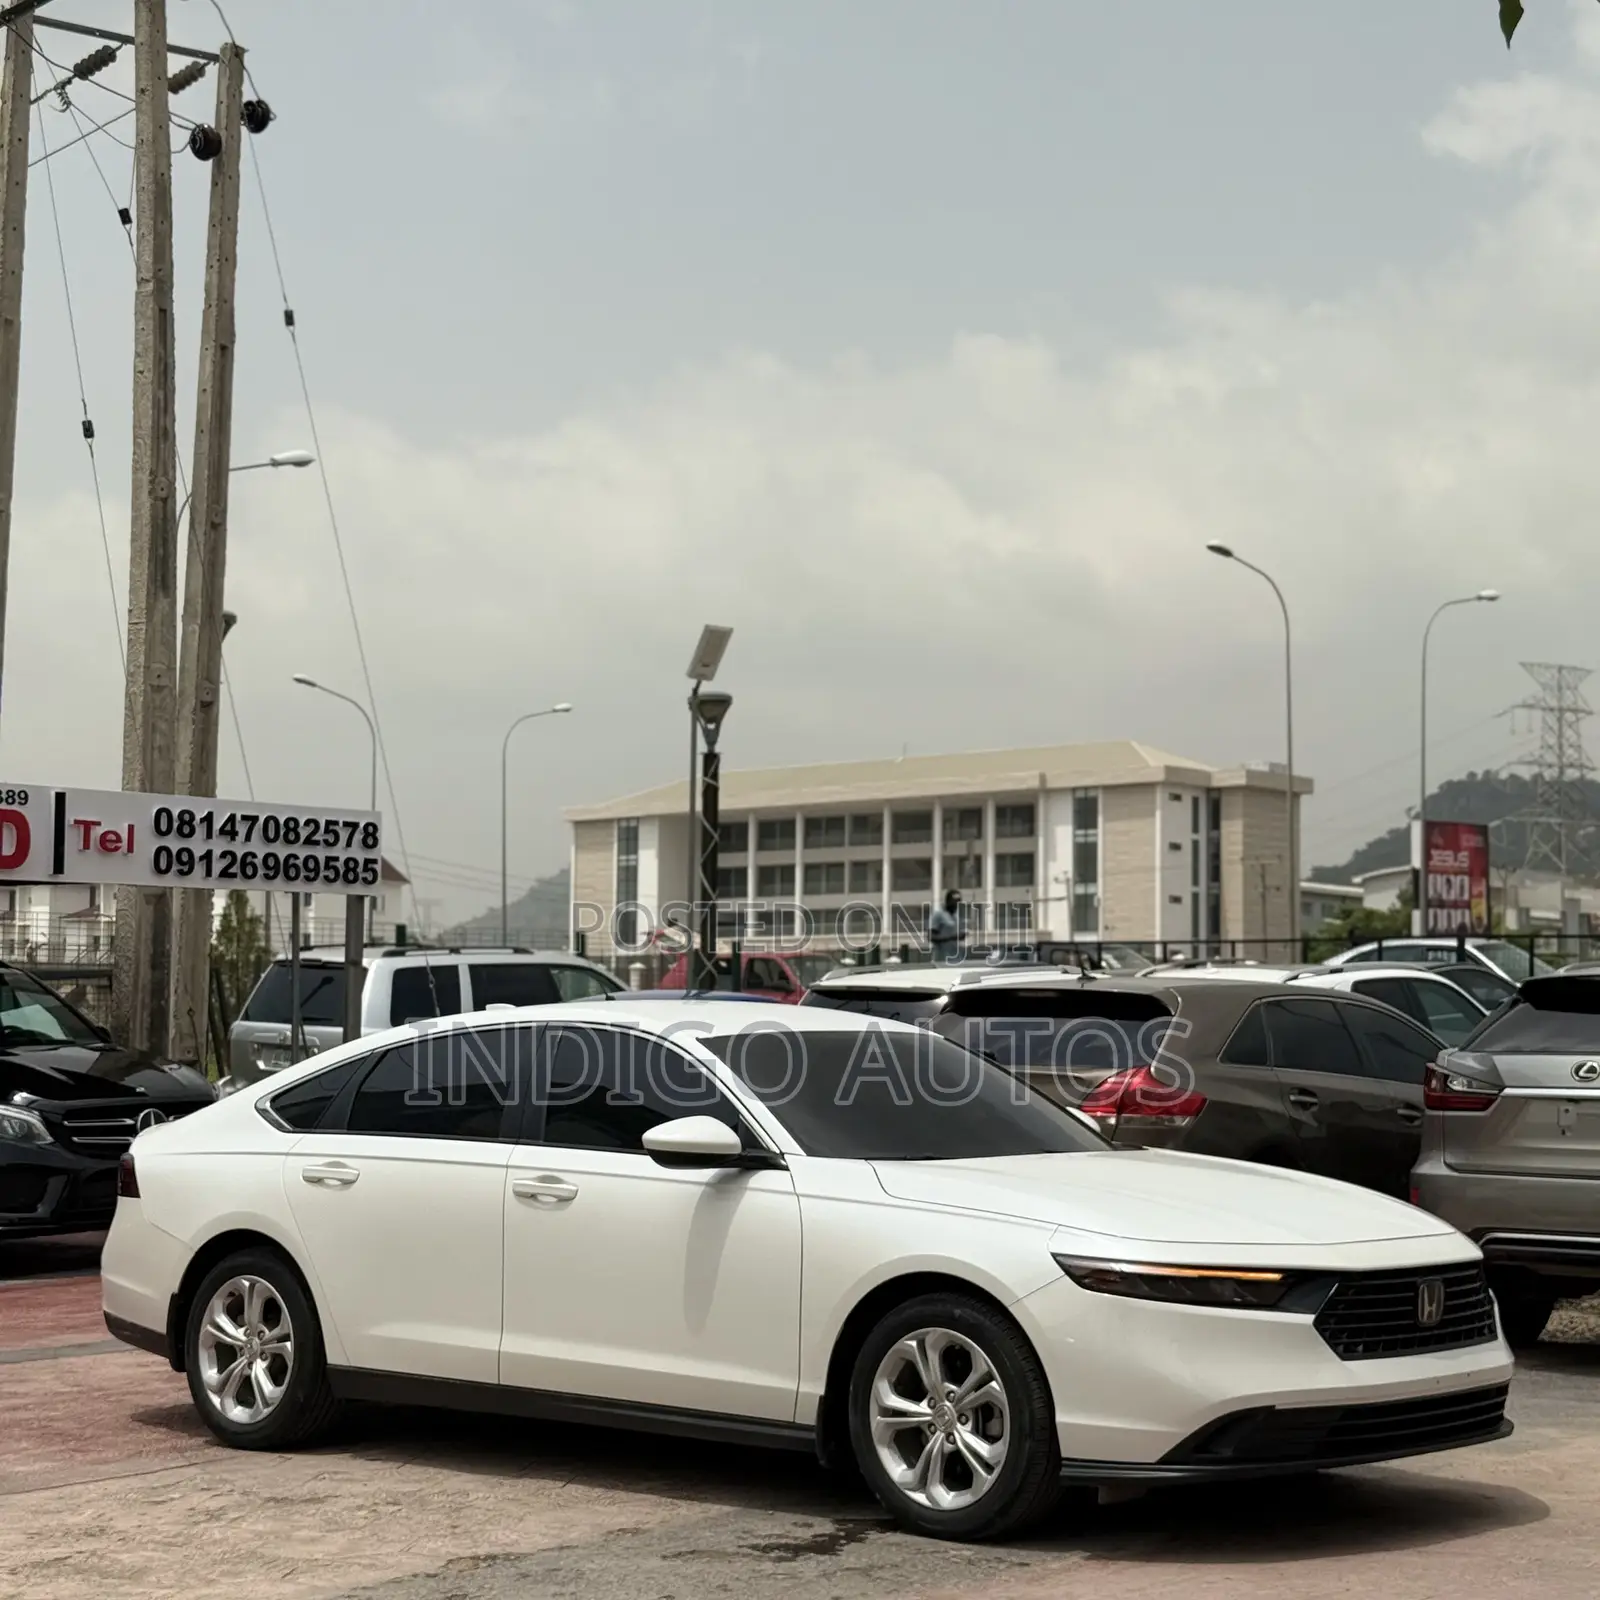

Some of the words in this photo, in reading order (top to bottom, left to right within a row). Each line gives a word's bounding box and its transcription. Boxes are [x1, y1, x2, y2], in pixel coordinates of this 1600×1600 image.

[73, 819, 134, 854] Tel
[153, 807, 379, 849] 08147082578
[153, 845, 379, 885] 09126969585
